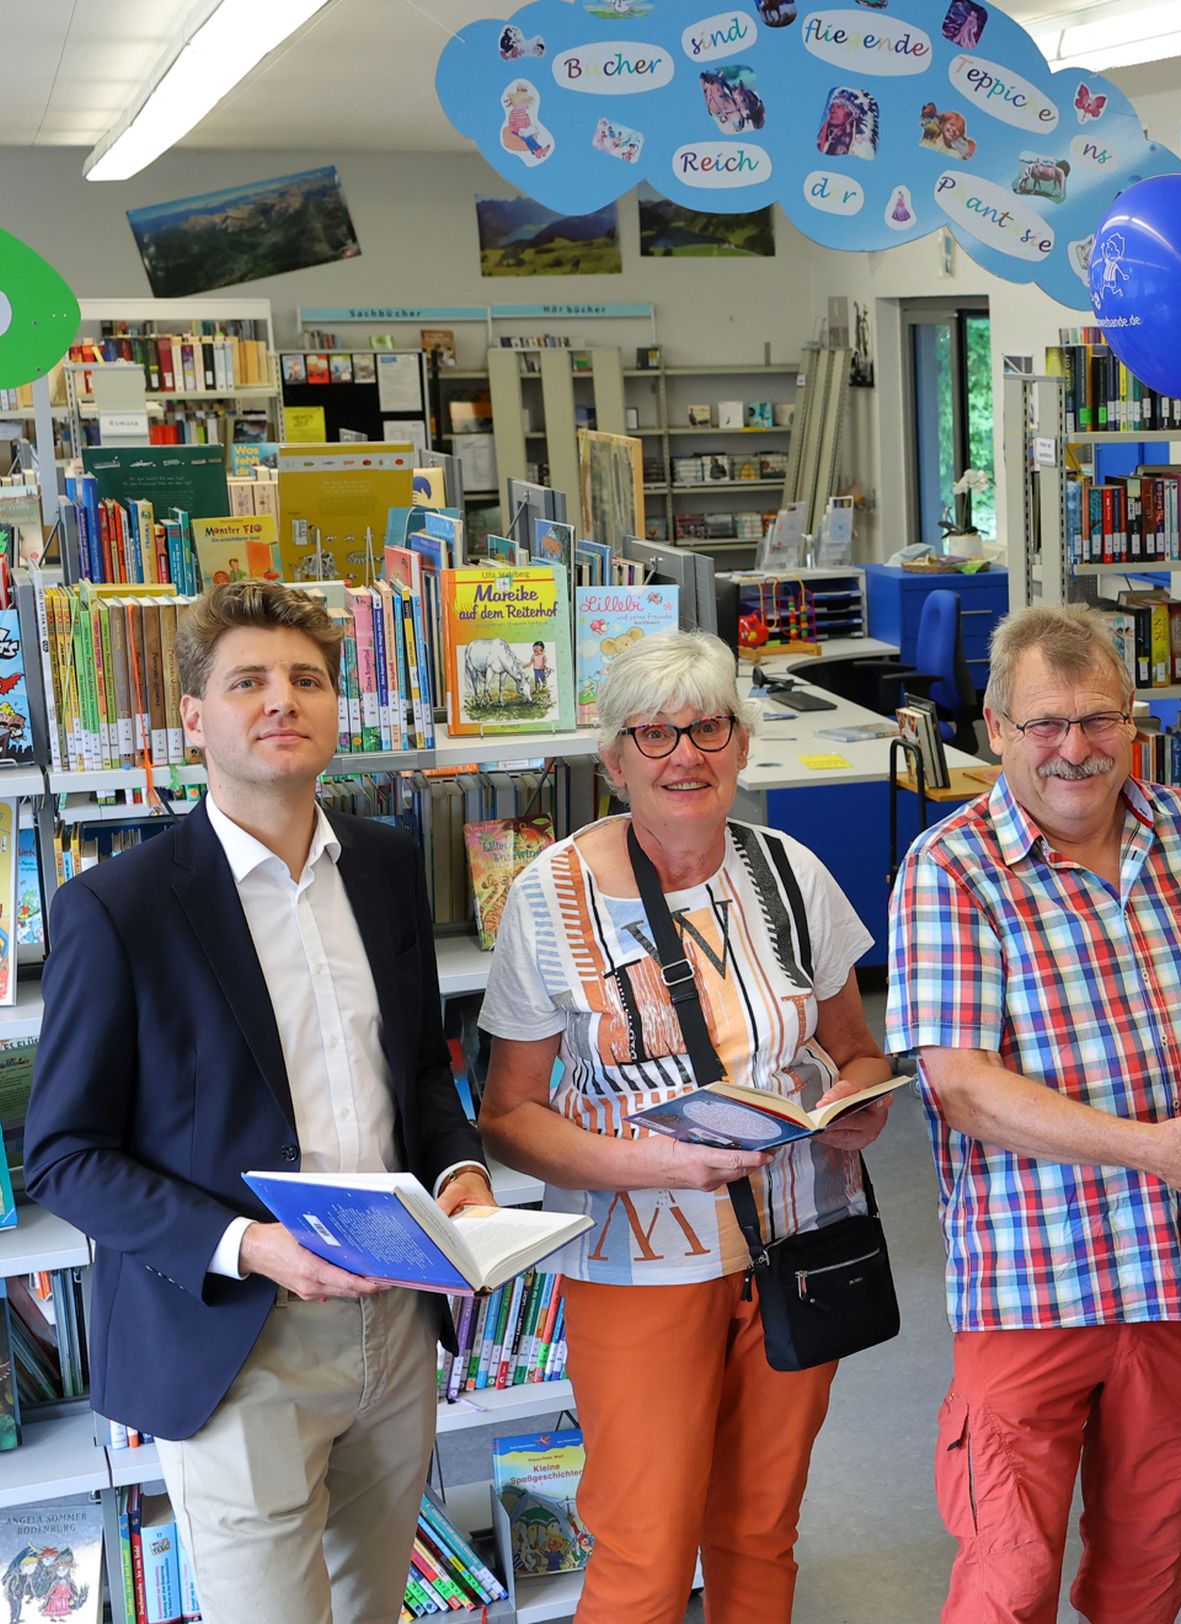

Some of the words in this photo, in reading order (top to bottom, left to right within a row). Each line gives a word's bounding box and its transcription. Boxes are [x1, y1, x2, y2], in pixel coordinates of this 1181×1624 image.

[691, 17, 747, 55] sind
[804, 18, 929, 57] fliegende
[564, 54, 662, 79] Bücher
[954, 55, 1056, 122] Teppiche
[680, 150, 760, 173] Reich
[811, 178, 856, 205] der
[937, 176, 1052, 254] Phantasie
[350, 309, 421, 318] Sachbücher
[544, 305, 606, 314] Hörbücher
[236, 446, 259, 455] Was
[236, 456, 260, 466] fehlt
[205, 526, 240, 537] Monster
[474, 585, 538, 603] Mareike
[459, 605, 477, 620] auf
[481, 605, 503, 618] dem
[508, 602, 558, 618] Reiterhof
[580, 596, 644, 613] Lillebi
[533, 1464, 560, 1473] Kleine
[5, 1515, 43, 1526] ANGELA
[46, 1513, 87, 1523] SOMMER
[17, 1524, 76, 1536] BODENBURG
